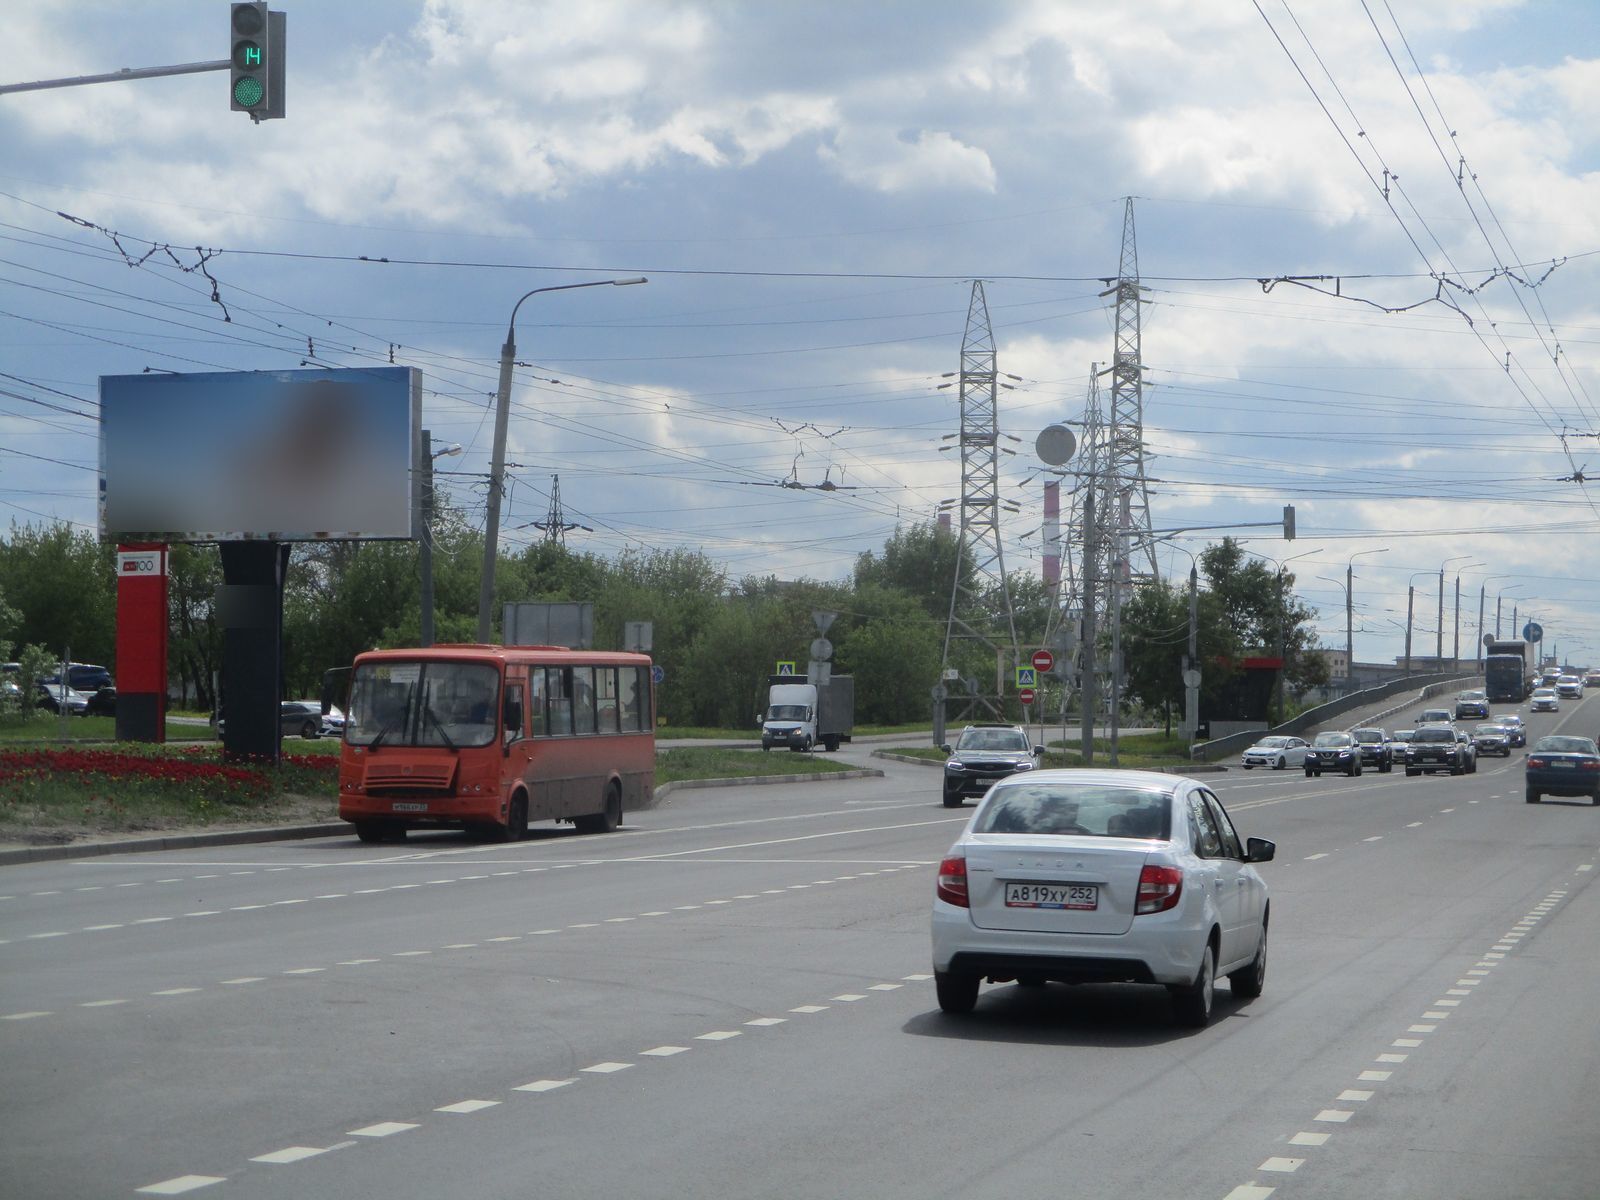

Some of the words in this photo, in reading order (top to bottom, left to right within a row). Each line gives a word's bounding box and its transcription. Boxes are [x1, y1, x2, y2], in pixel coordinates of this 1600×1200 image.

[246, 47, 261, 65] 14
[1012, 886, 1067, 902] А819ХУ
[1071, 887, 1092, 900] 252
